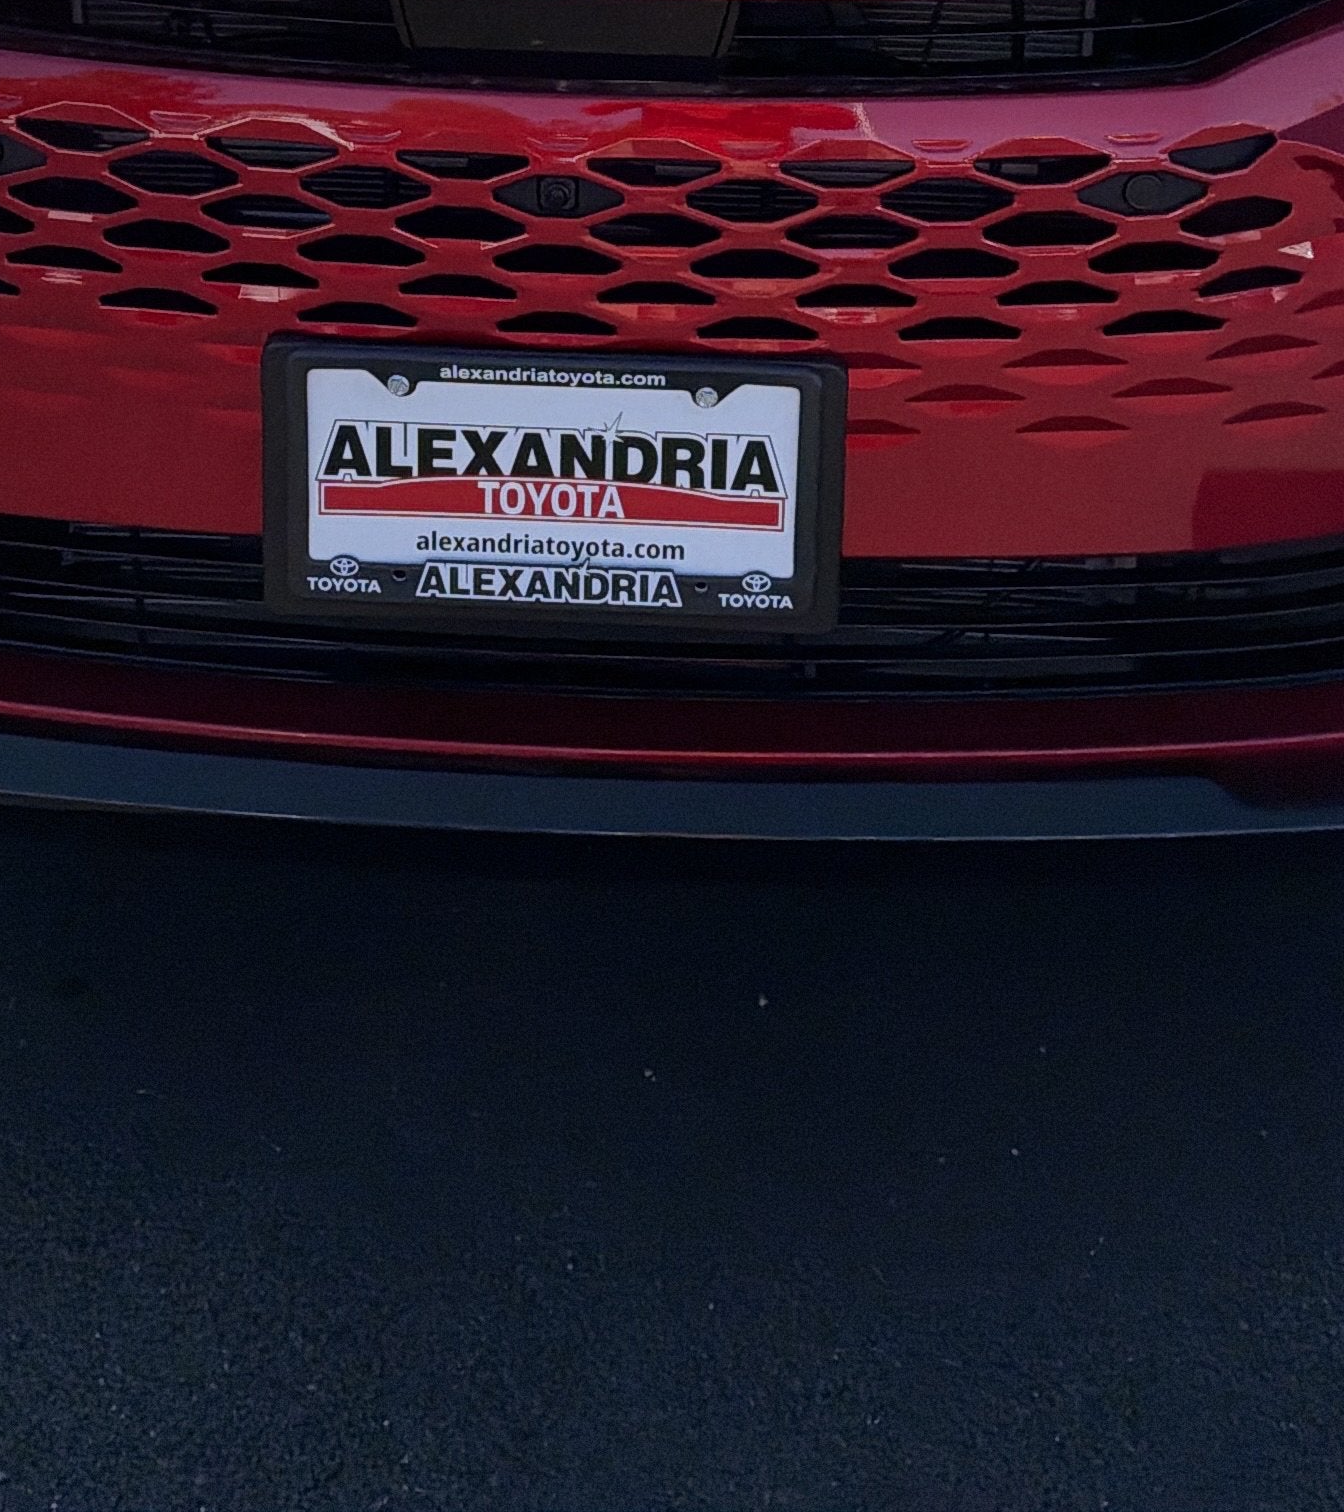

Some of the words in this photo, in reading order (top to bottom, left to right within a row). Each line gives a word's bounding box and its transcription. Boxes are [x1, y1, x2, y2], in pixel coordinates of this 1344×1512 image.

[439, 364, 667, 387] alexandriatoyota.com
[319, 421, 784, 496] ALEXANDRIA
[477, 481, 625, 519] TOYOTA
[416, 531, 685, 561] alexandriatoyota.com
[307, 576, 382, 594] TOYOTA
[415, 562, 682, 607] ALEXANDRIA
[718, 593, 793, 610] TOYOTA
